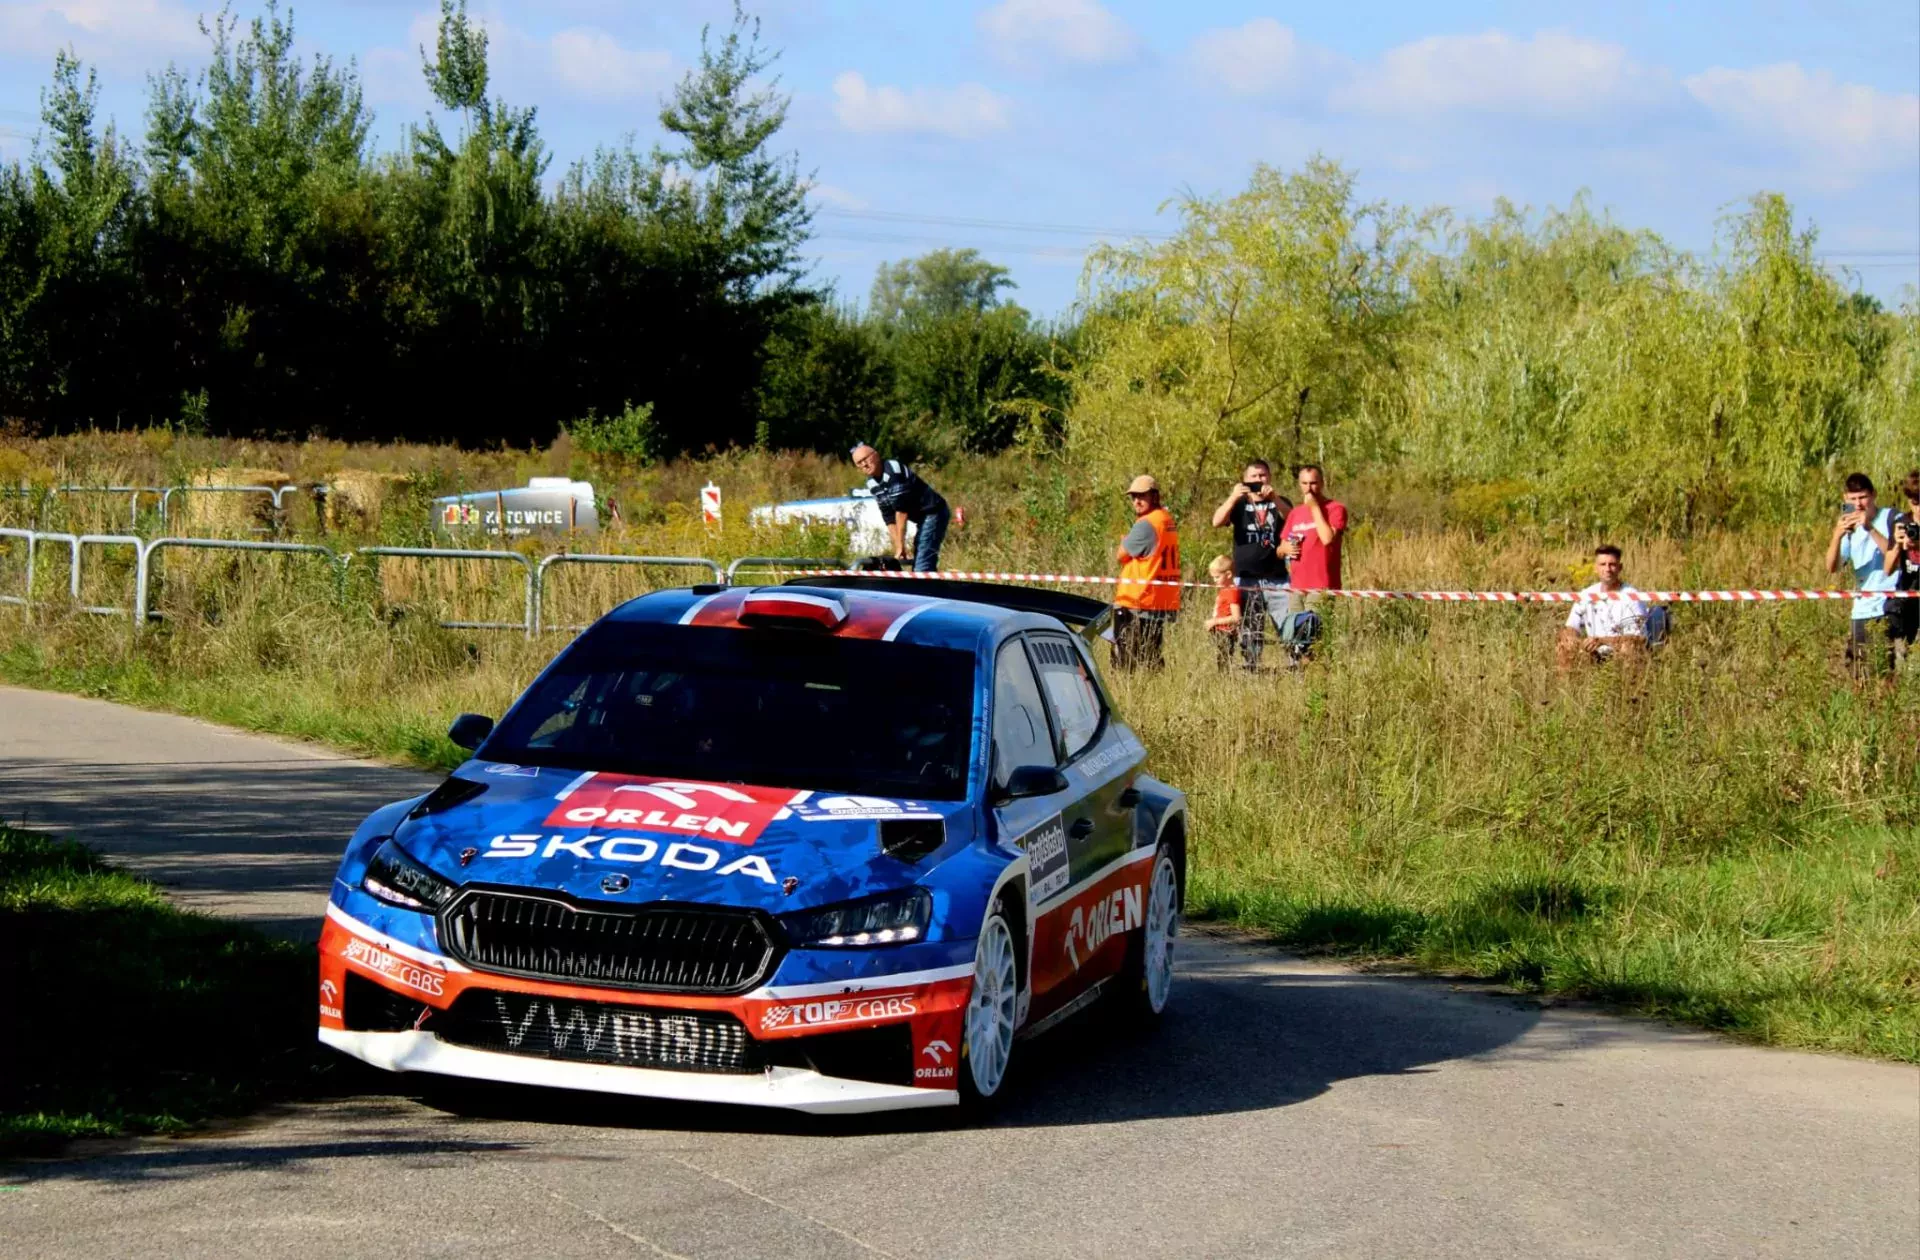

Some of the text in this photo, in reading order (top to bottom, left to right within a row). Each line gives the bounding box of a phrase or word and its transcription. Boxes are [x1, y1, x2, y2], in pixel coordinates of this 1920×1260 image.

[565, 807, 750, 837] ORLEN
[1086, 884, 1142, 952] ORLEN
[359, 942, 445, 996] TOP CARS
[792, 997, 917, 1024] TOP CARS
[915, 1067, 954, 1079] ORLEN
